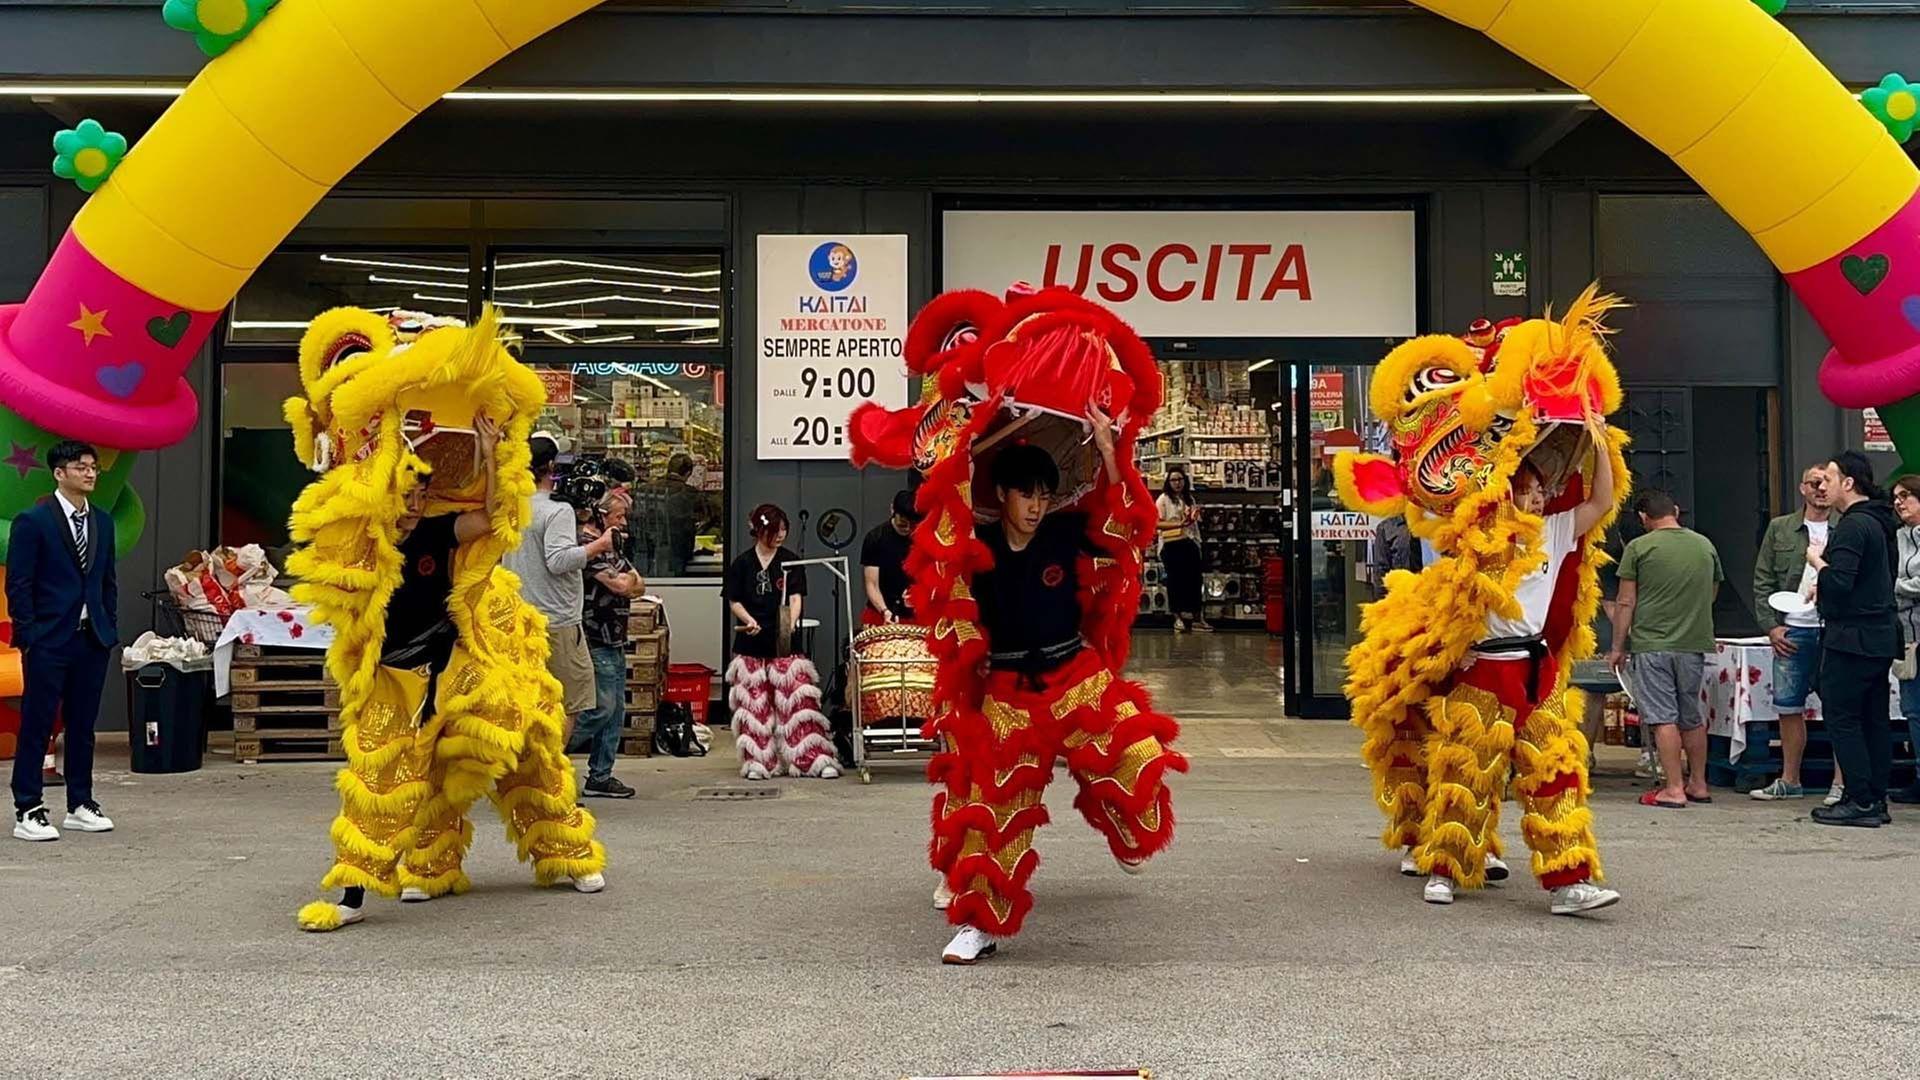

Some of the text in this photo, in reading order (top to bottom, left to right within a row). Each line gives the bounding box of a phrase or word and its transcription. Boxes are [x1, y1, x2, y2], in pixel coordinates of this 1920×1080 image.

[1042, 243, 1312, 303] USCITA
[799, 296, 867, 313] KAITAI
[780, 318, 887, 331] MERCATONE
[763, 337, 902, 358] SEMPRE APERTO
[773, 367, 876, 398] DALLE 9:00
[771, 416, 843, 446] ALLE 20:
[1320, 514, 1370, 526] KAITAI
[1311, 529, 1377, 538] MERCATON
